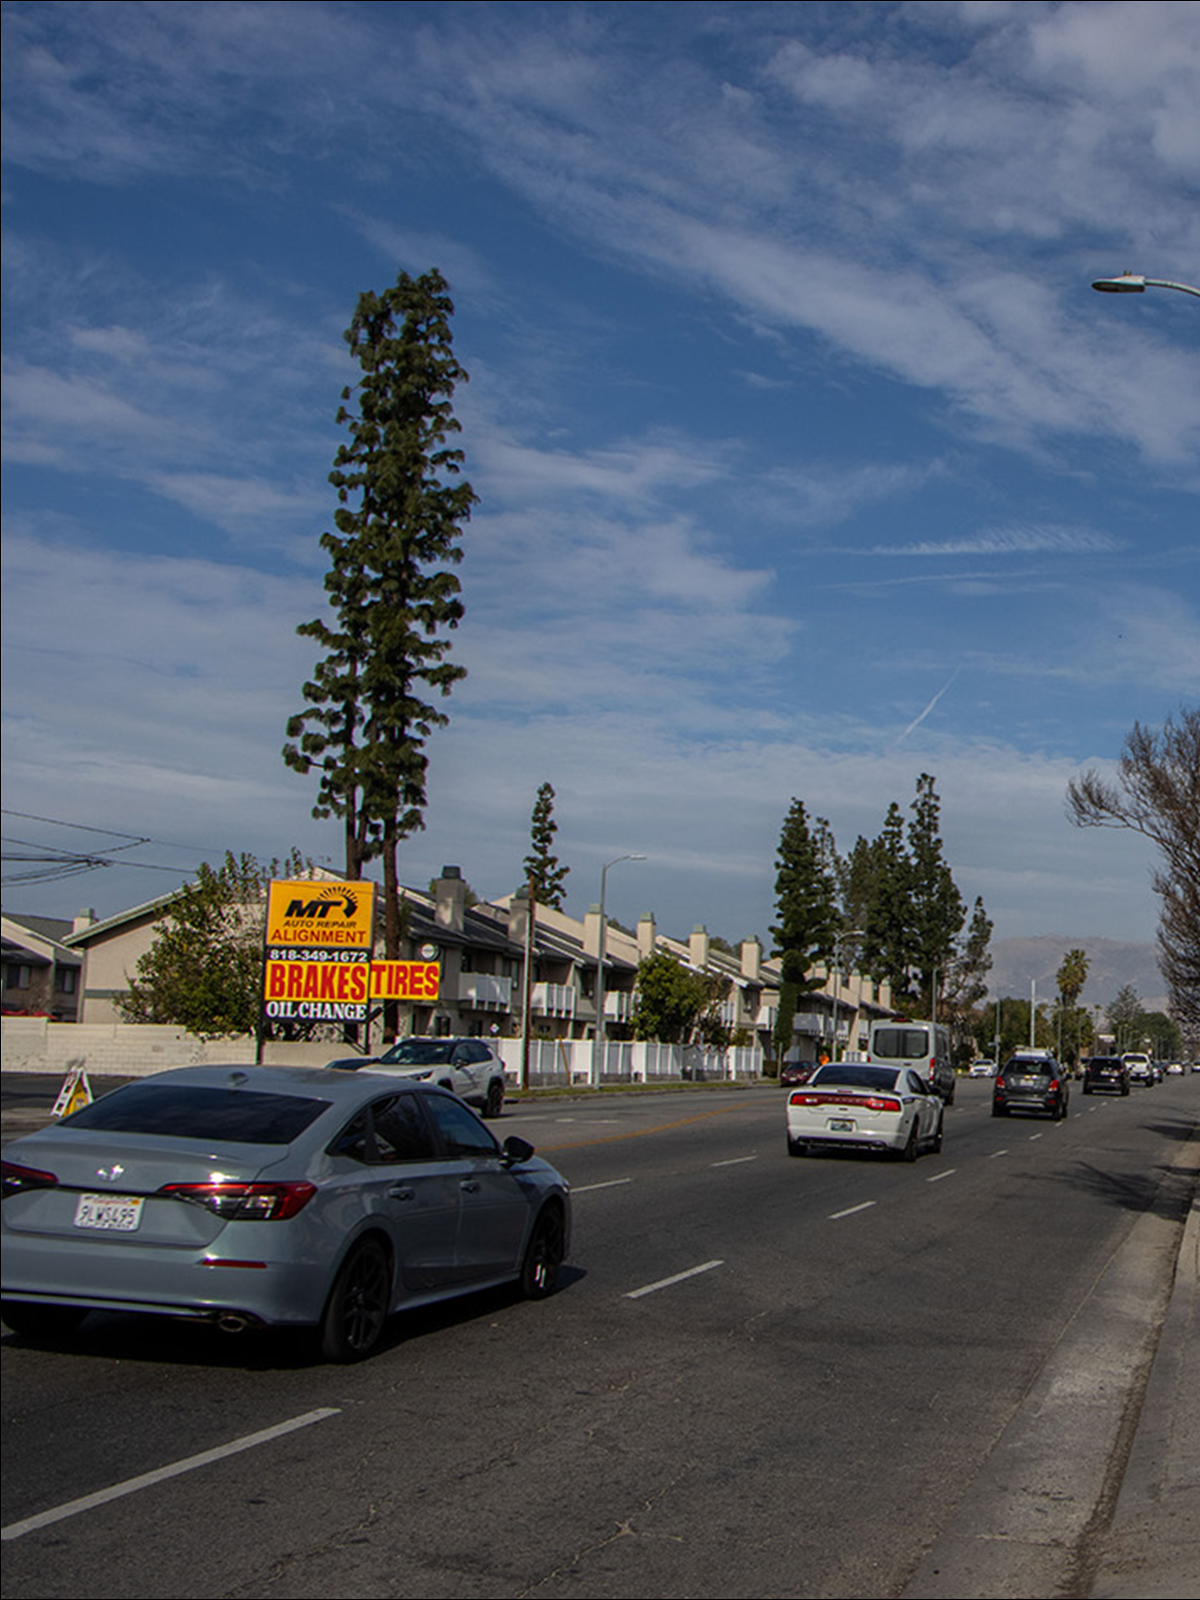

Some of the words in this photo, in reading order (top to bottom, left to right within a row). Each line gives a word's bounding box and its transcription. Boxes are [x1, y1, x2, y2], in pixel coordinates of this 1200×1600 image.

[282, 919, 314, 928] AUTO
[316, 920, 357, 928] REPAIR
[271, 928, 367, 943] ALIGNMENT
[269, 949, 368, 963] 818-349-1672
[269, 963, 367, 1000] BRAKES
[371, 964, 439, 996] TIRES
[266, 1001, 297, 1018] OIL
[298, 1002, 367, 1020] CHANGE
